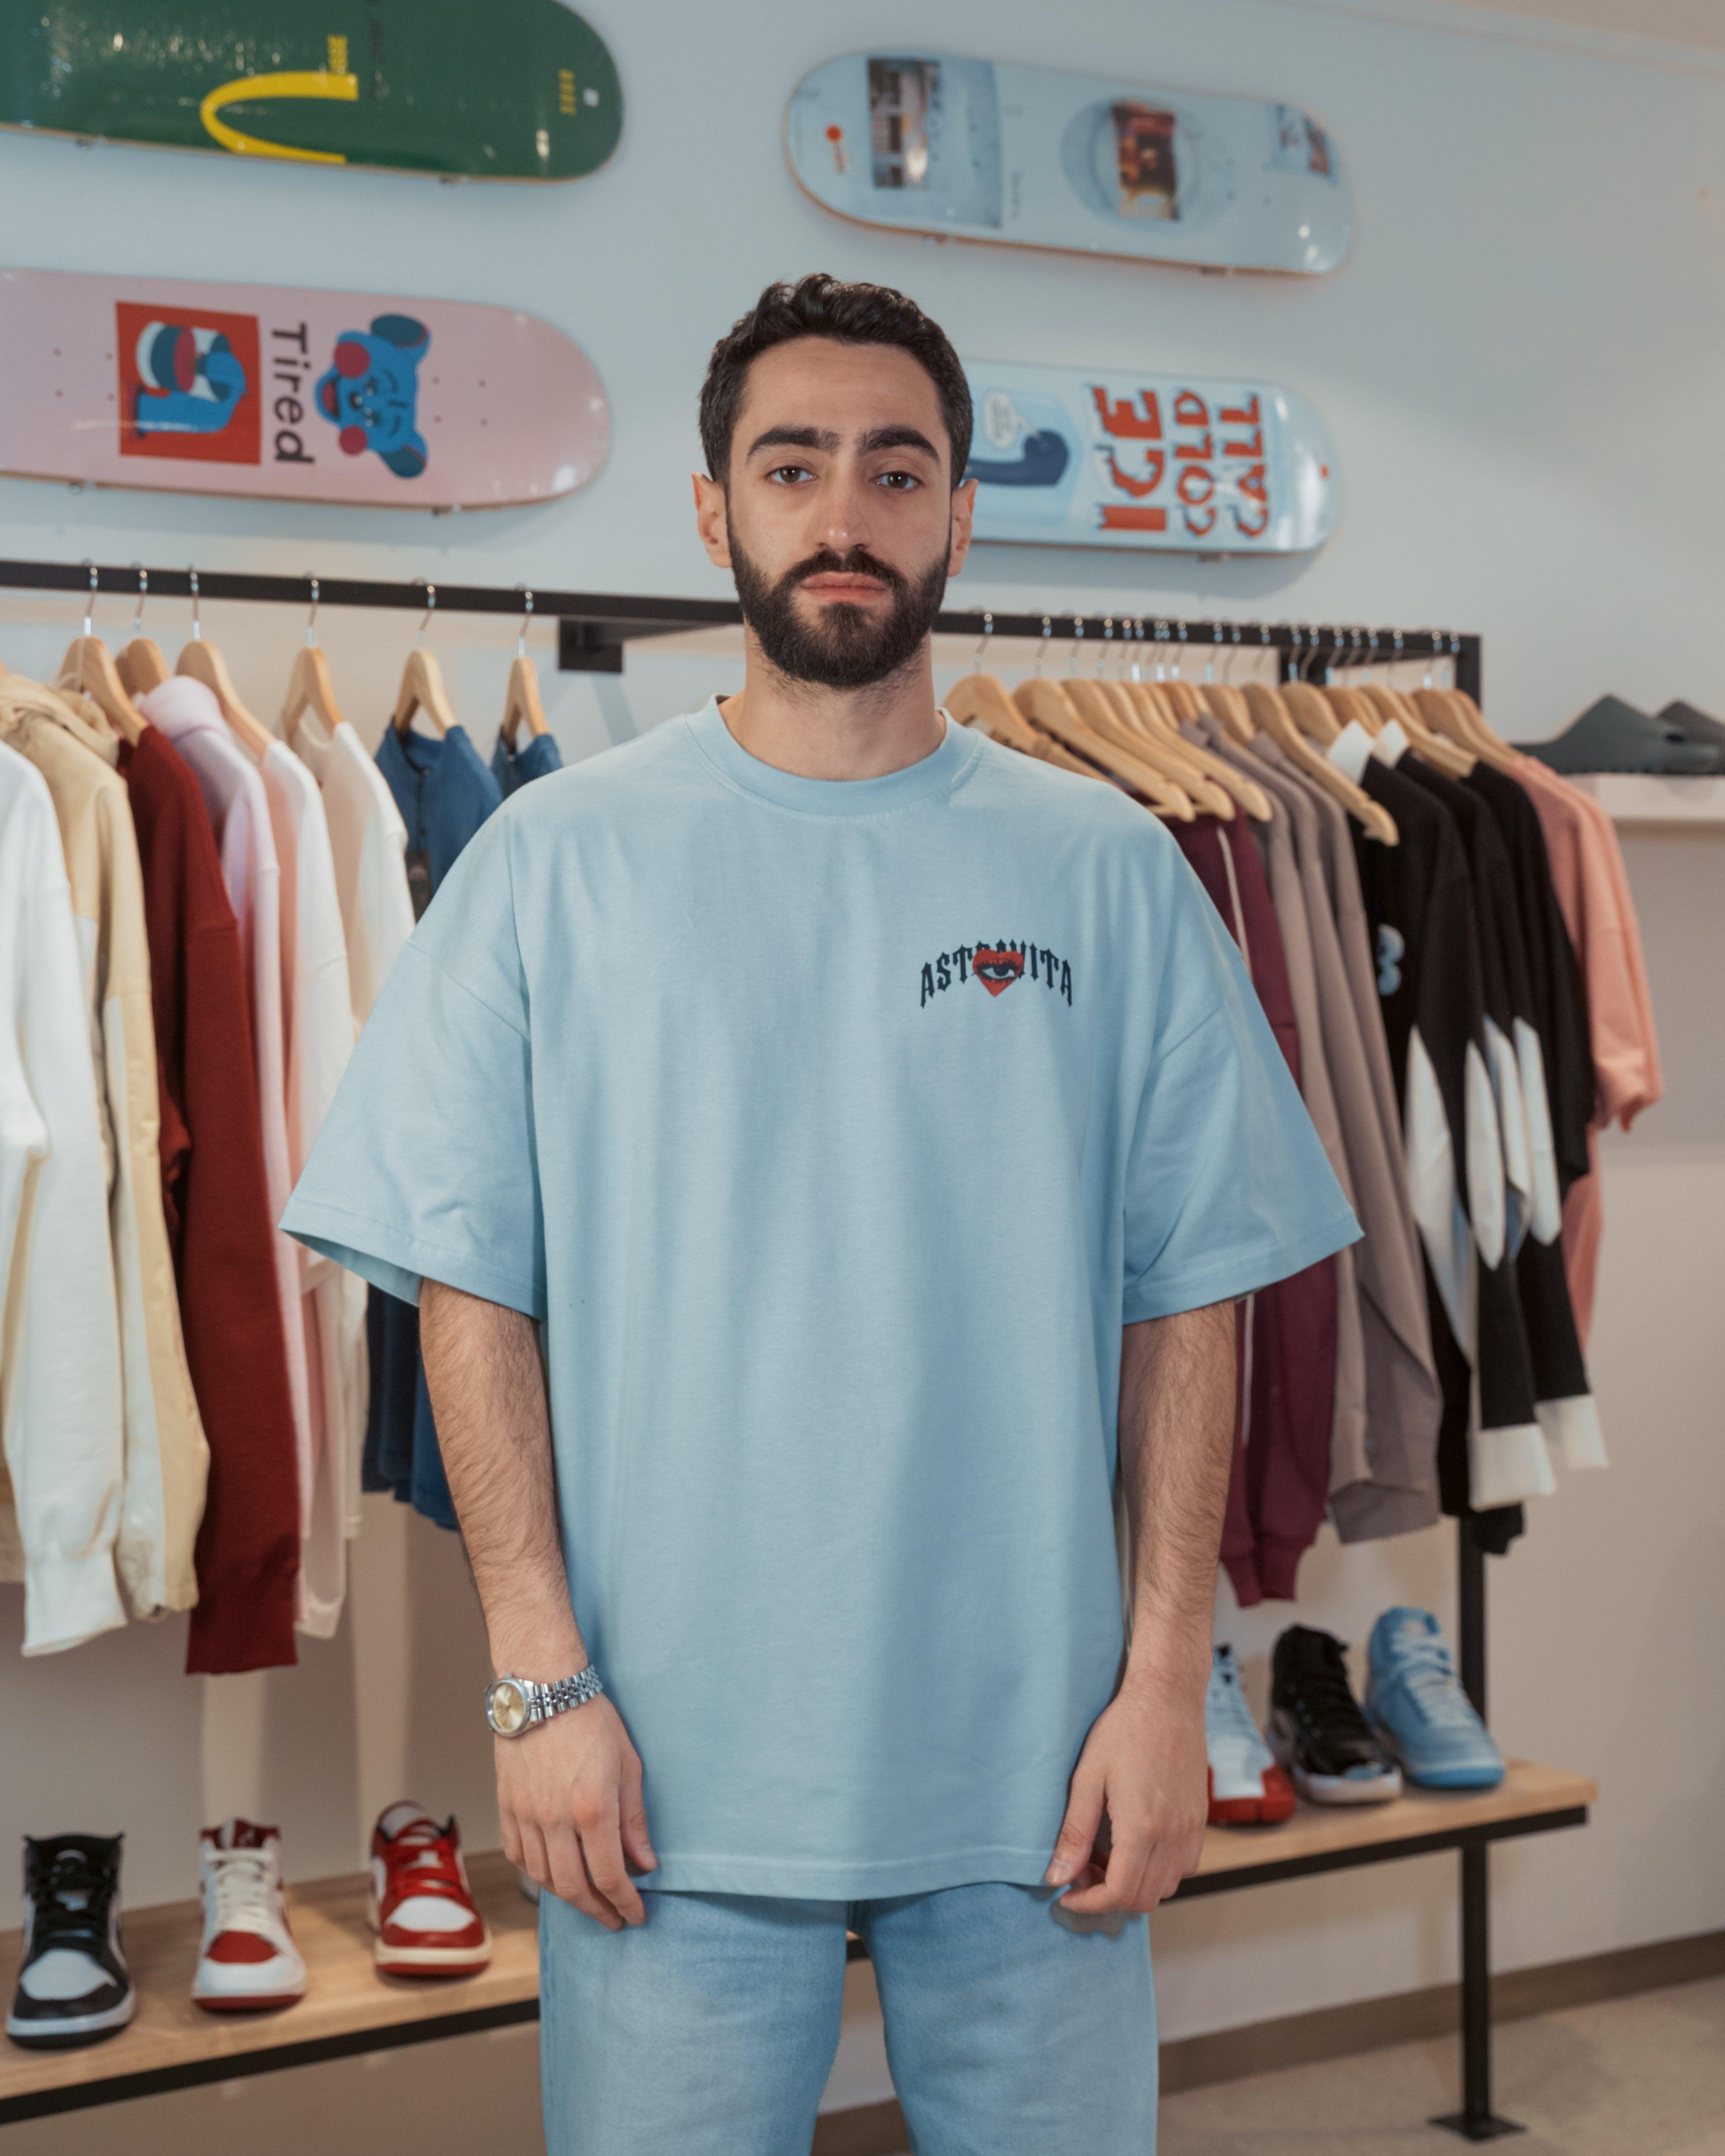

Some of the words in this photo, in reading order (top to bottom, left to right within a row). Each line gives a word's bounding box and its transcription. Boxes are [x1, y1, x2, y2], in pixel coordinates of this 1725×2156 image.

[272, 320, 315, 464] Tired
[1089, 385, 1167, 534] ICE
[1172, 389, 1217, 537] COLD
[1219, 394, 1269, 539] CALL
